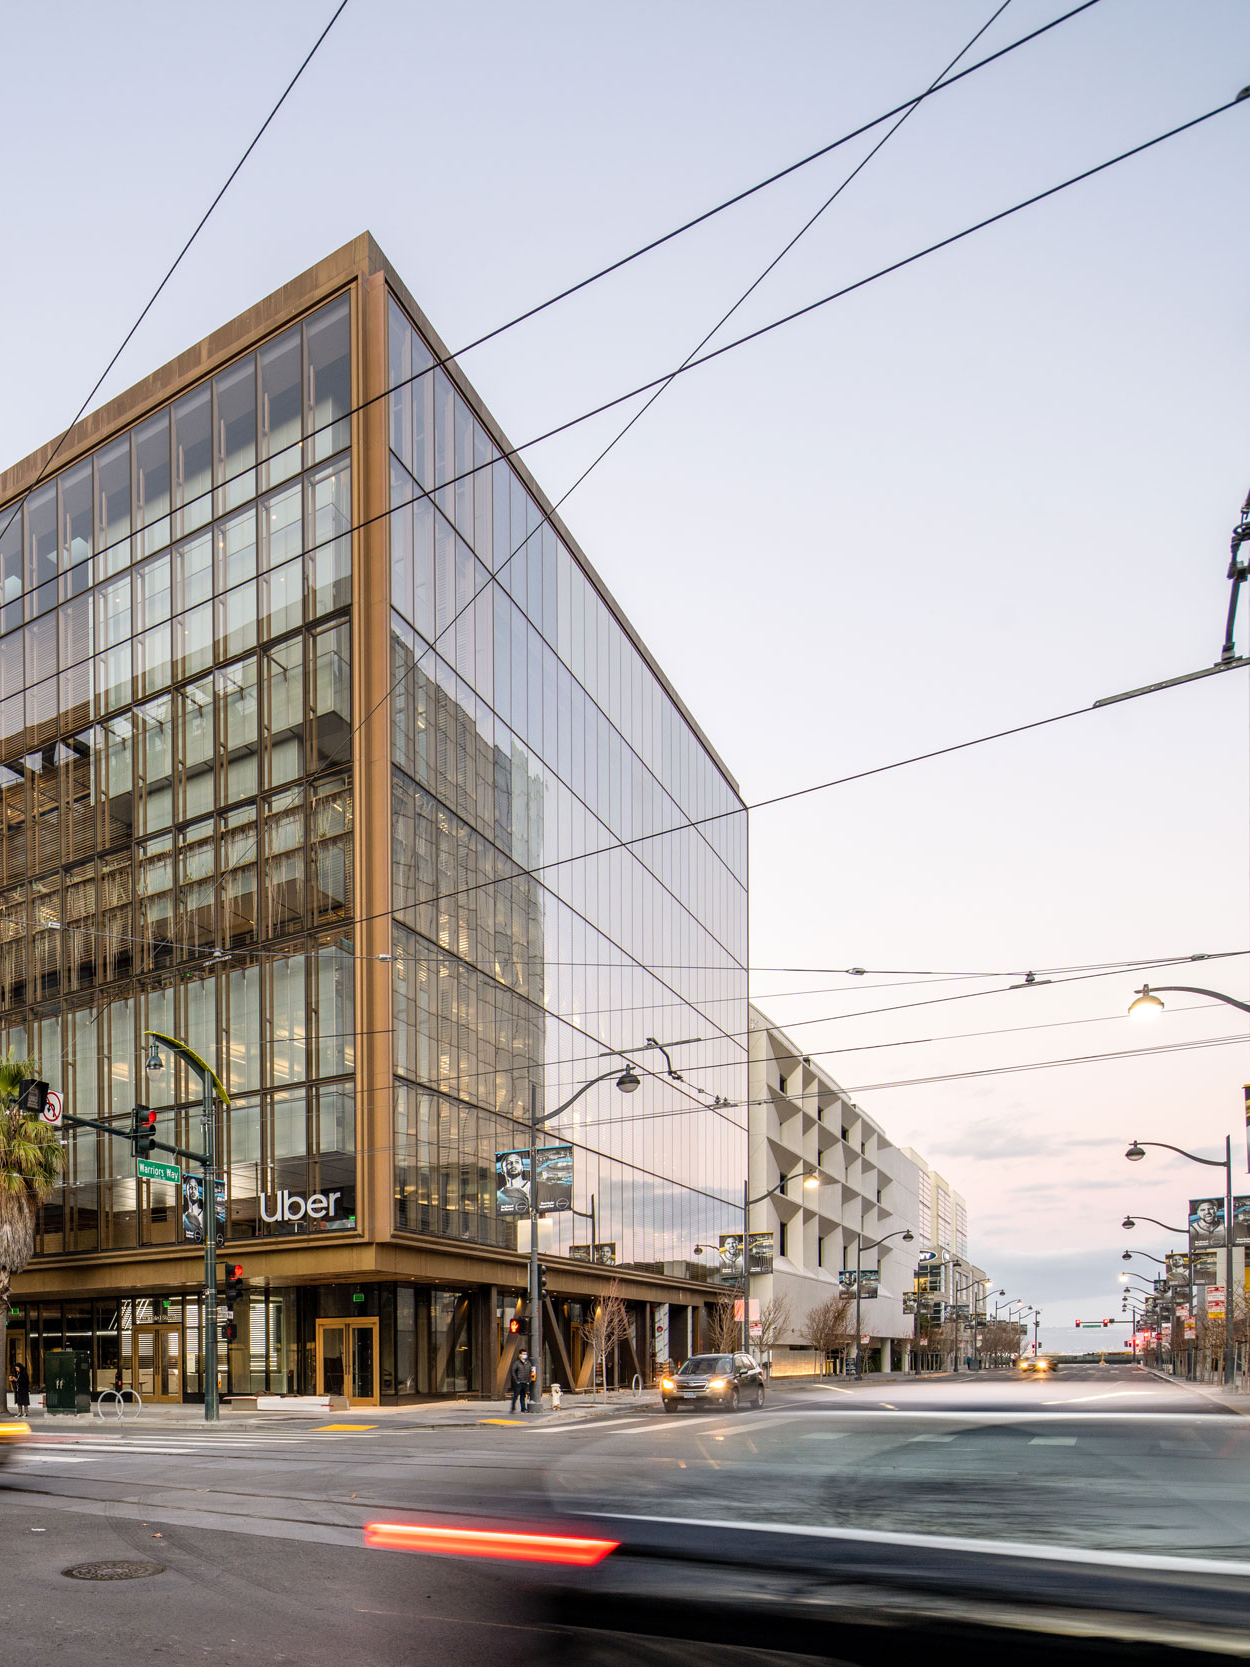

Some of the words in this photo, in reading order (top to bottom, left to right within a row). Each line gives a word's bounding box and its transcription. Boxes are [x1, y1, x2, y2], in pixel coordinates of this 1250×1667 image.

[139, 1163, 164, 1177] Warriors
[166, 1168, 178, 1182] Way
[260, 1189, 341, 1222] Uber
